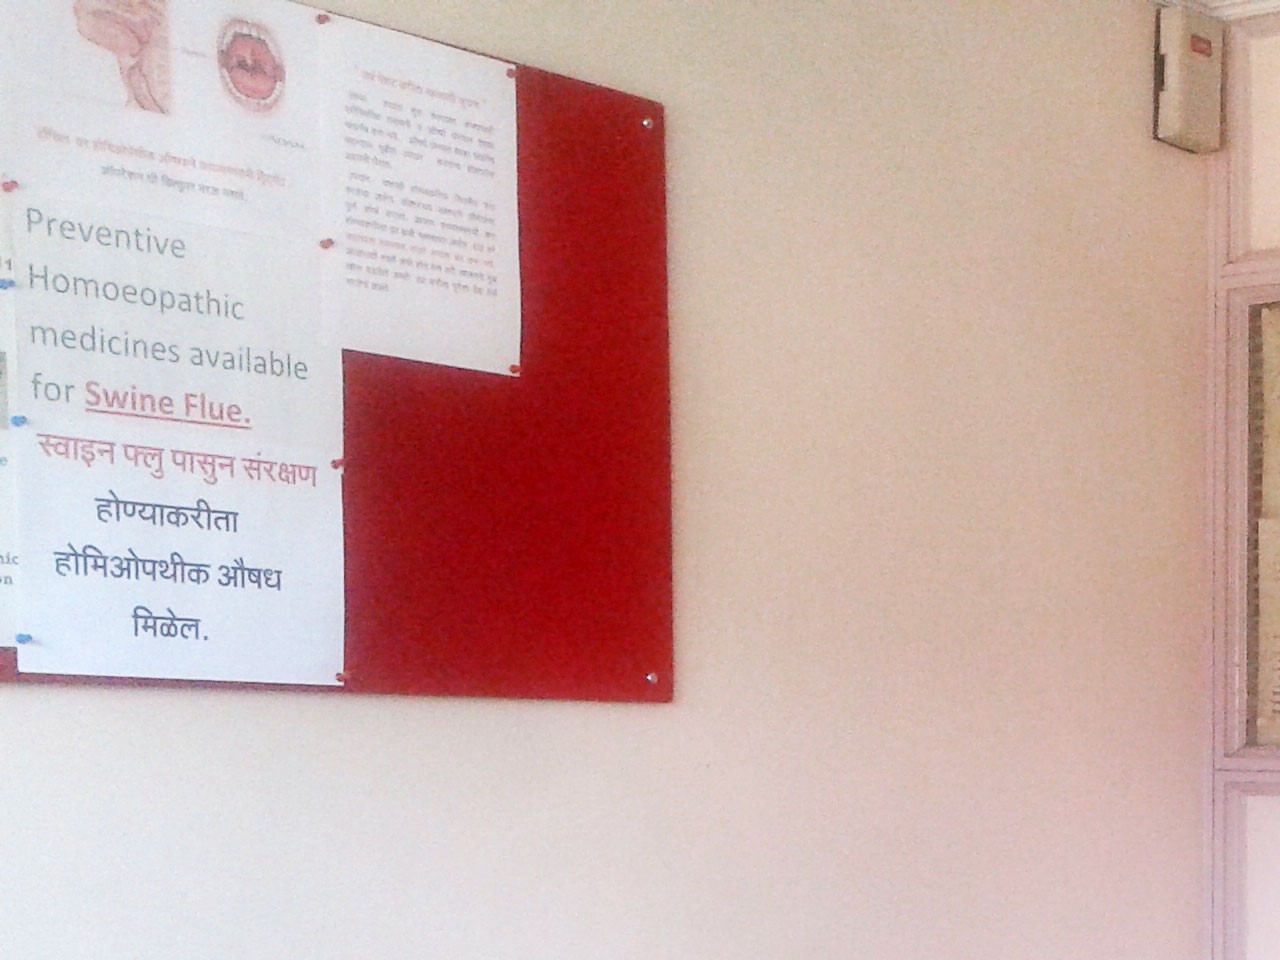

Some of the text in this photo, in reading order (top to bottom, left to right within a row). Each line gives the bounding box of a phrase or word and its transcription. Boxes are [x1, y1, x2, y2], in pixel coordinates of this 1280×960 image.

[26, 207, 187, 259] Preventive
[29, 265, 245, 321] Homoeopathic
[31, 324, 309, 380] medicines available
[31, 373, 251, 425] for Swine Flue.
[37, 432, 318, 488] स्वाइन फ्लु पासुन संरक्षण
[95, 490, 239, 533] होण्याकरीता
[218, 557, 283, 591] औषध
[132, 605, 209, 641] मिळेल.
